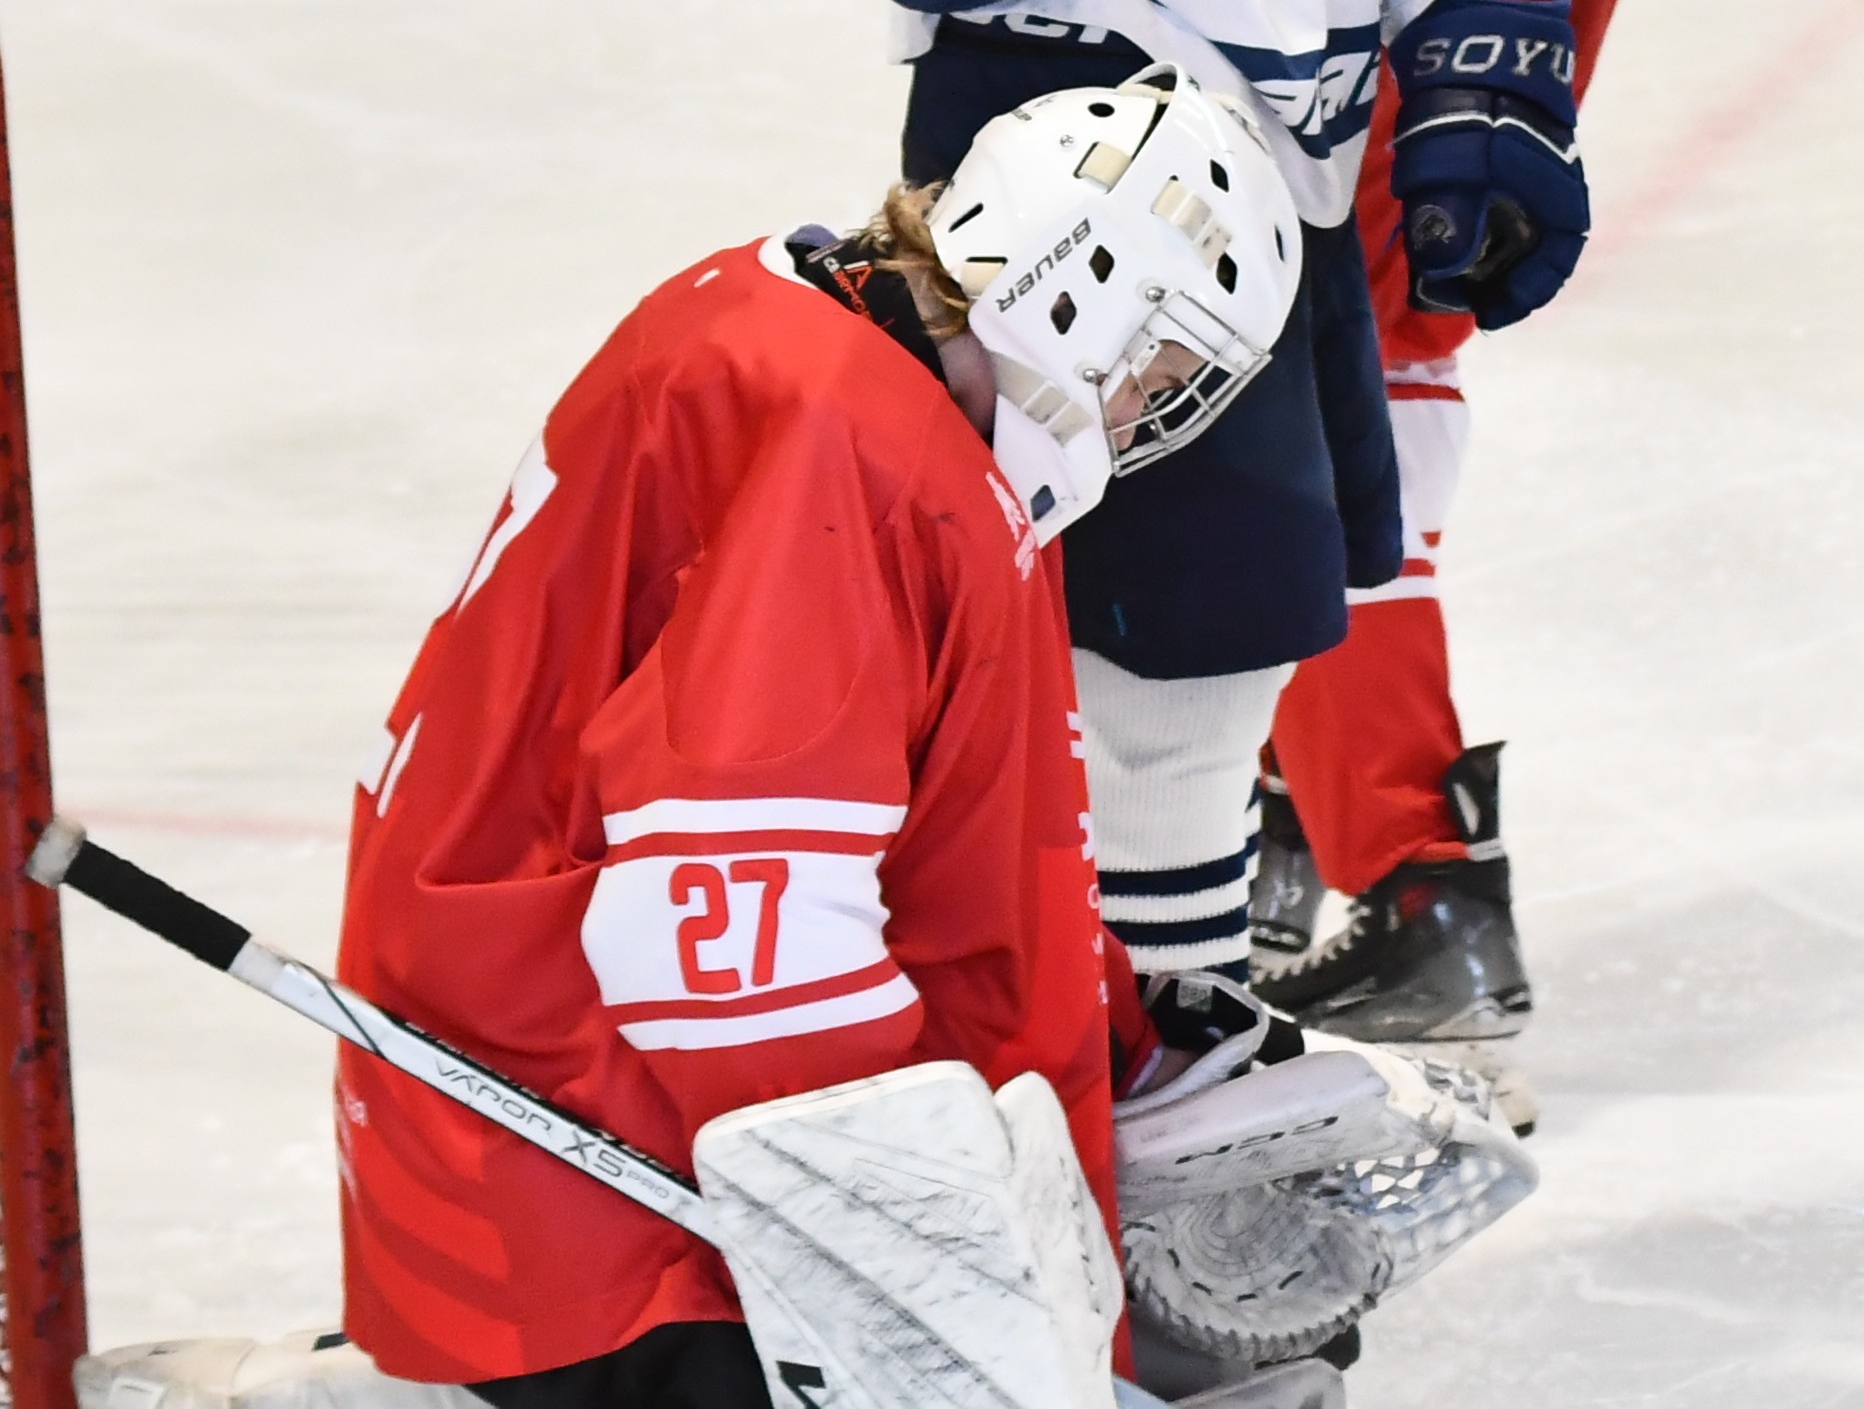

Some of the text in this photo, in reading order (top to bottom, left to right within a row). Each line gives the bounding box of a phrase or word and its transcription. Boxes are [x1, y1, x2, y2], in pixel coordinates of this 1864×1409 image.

[997, 218, 1092, 313] BAUER
[670, 859, 789, 994] 27
[435, 1065, 552, 1133] VAPOR
[625, 1168, 671, 1200] PRO
